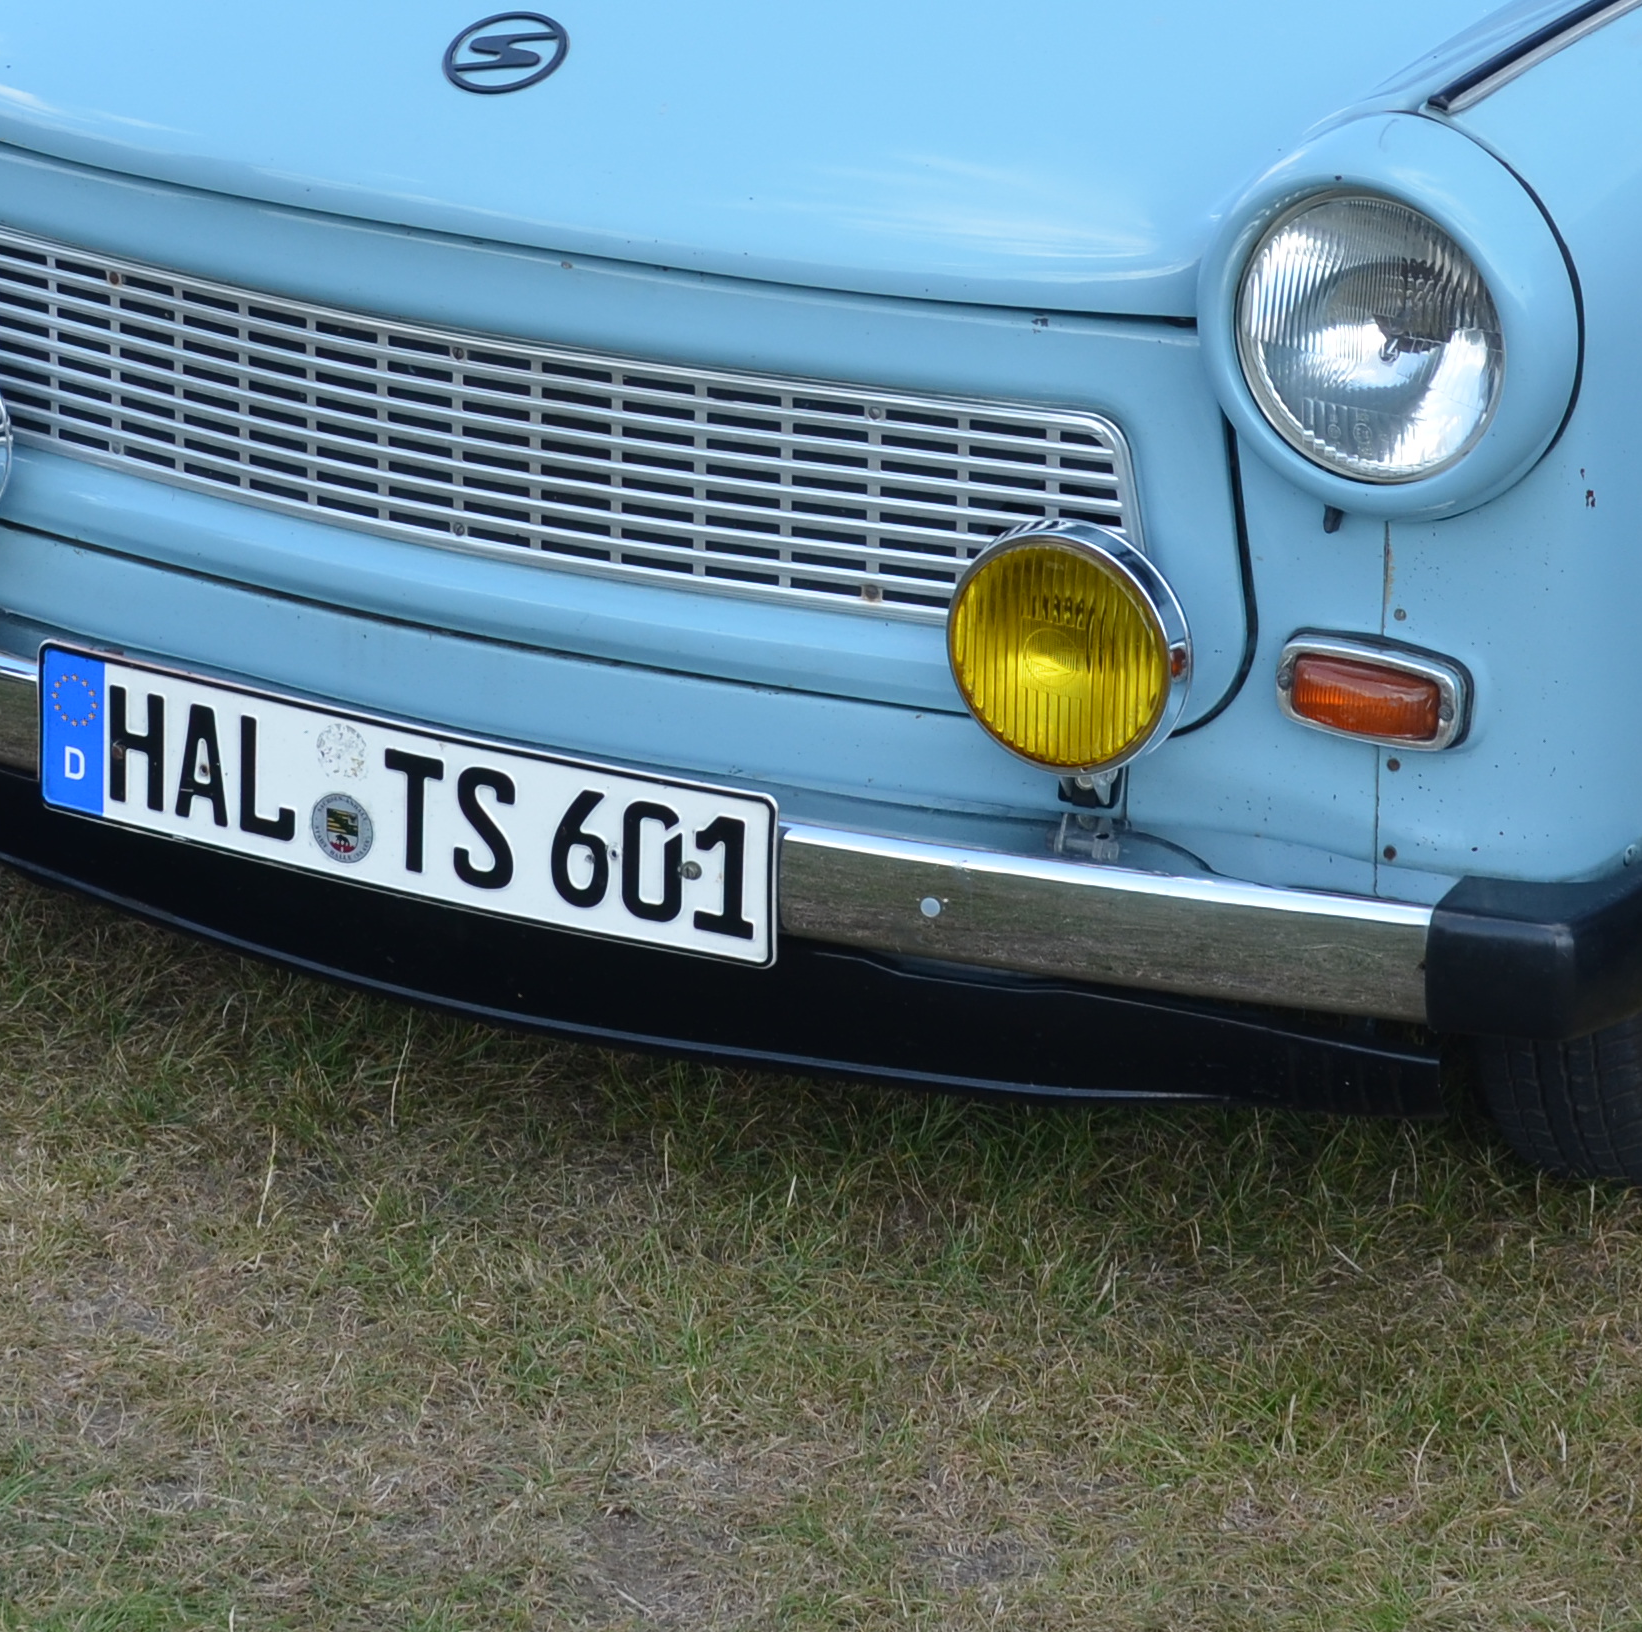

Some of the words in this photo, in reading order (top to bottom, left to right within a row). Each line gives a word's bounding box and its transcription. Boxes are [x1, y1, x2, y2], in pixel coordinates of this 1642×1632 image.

[64, 745, 86, 781] D
[109, 684, 297, 842] HAL
[384, 747, 516, 890] TS
[550, 789, 755, 941] 601
